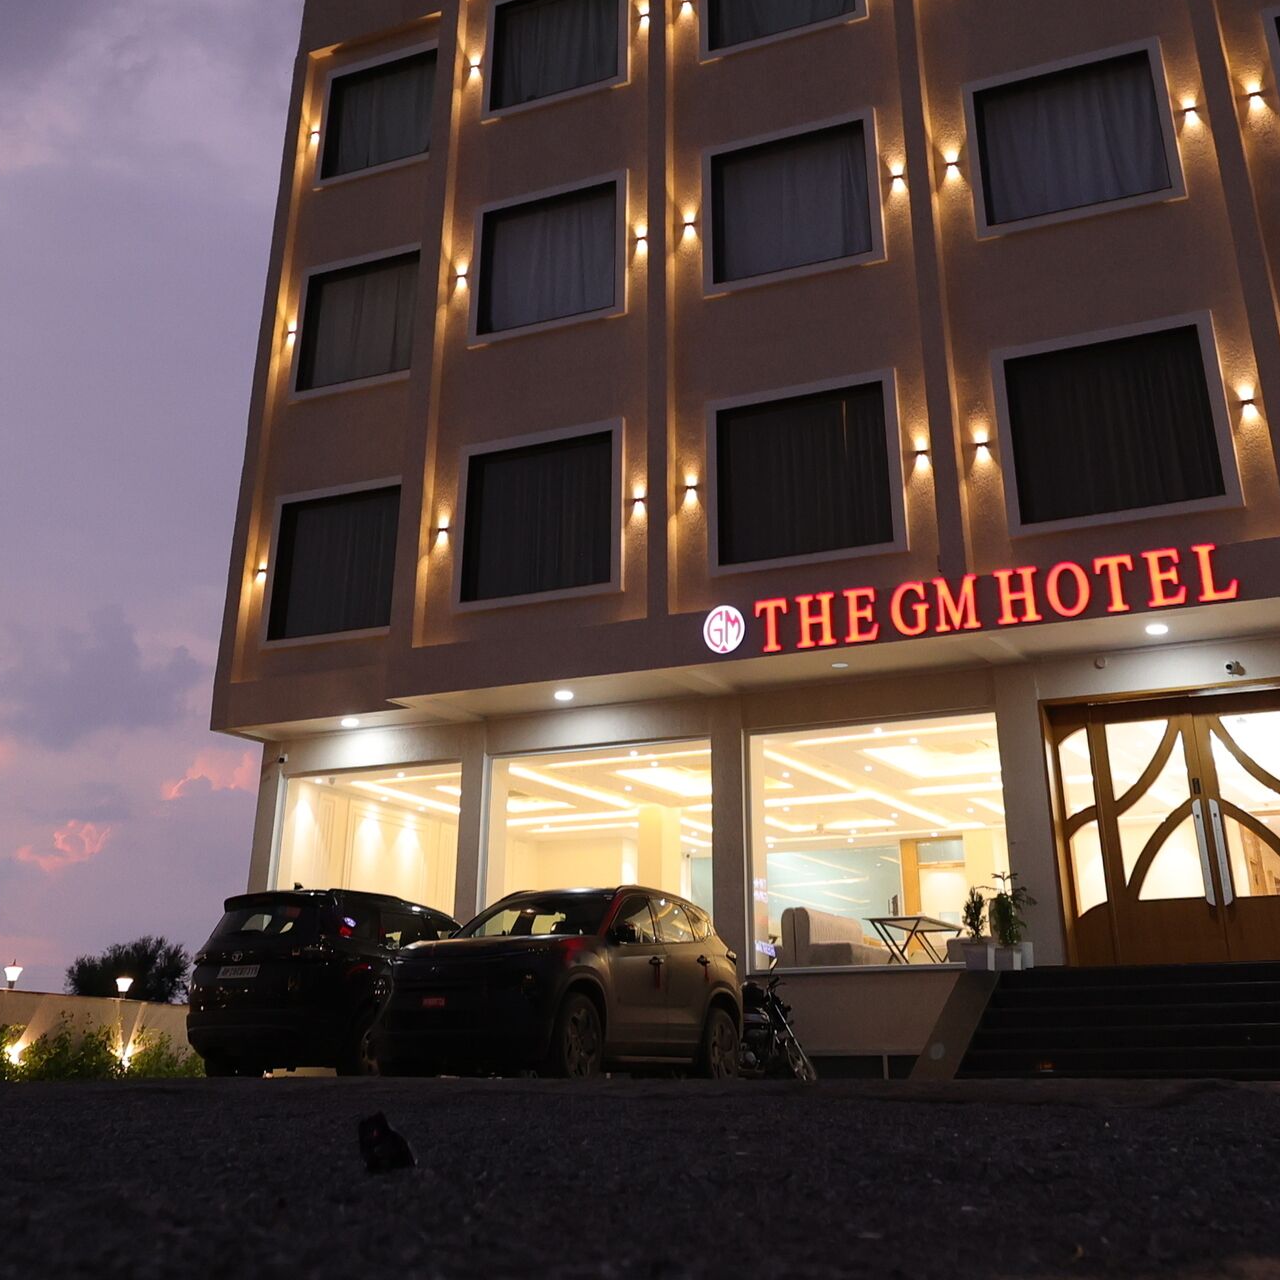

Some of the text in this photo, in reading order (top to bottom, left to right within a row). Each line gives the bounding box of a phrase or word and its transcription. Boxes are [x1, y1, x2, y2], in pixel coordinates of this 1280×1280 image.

[754, 585, 879, 653] THE
[889, 573, 983, 637] GM
[992, 542, 1240, 626] HOTEL
